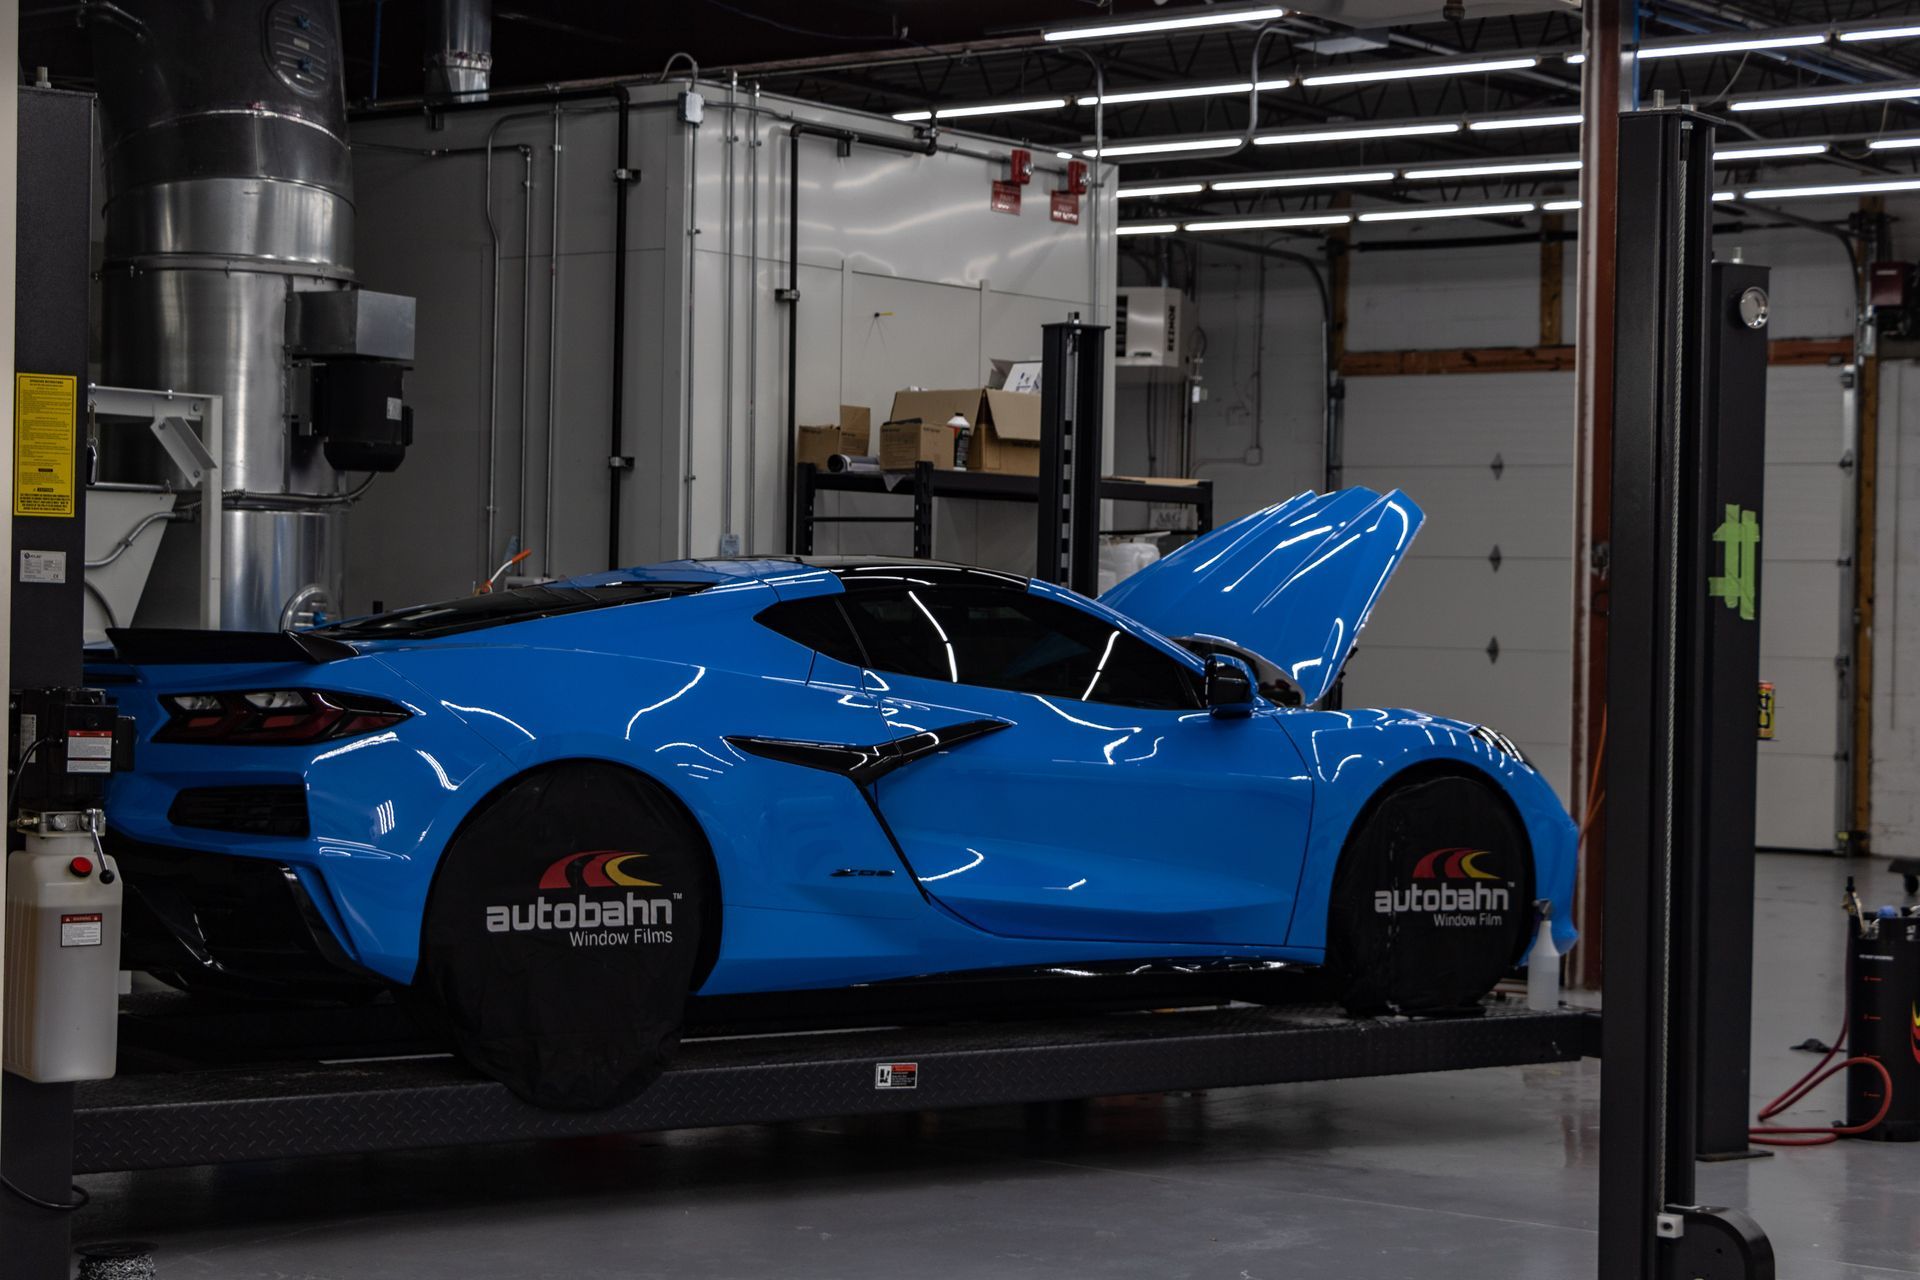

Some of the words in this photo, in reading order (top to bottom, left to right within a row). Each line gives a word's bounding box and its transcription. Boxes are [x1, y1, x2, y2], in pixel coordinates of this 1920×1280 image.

[1374, 881, 1509, 913] autobahn
[486, 891, 673, 932] autobahn
[1433, 913, 1477, 926] Window
[569, 930, 630, 947] Window
[634, 928, 673, 943] Films
